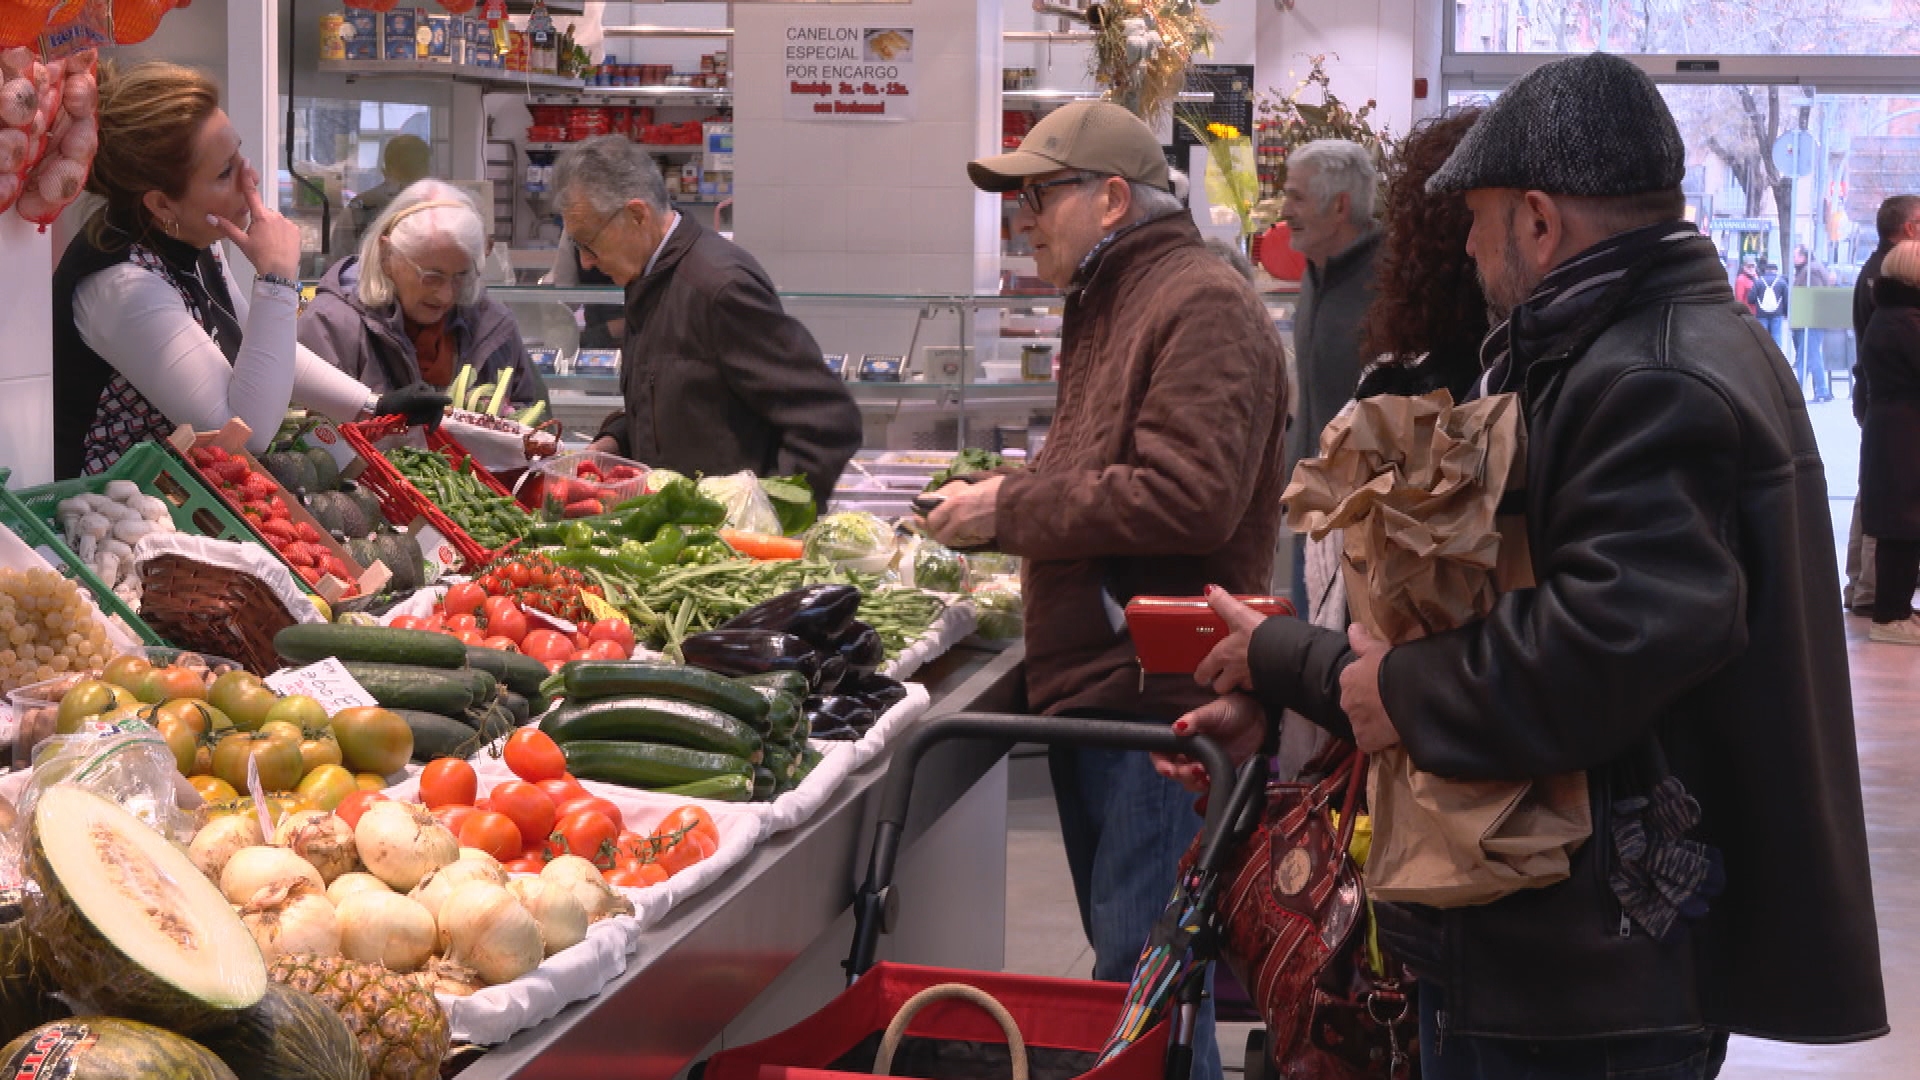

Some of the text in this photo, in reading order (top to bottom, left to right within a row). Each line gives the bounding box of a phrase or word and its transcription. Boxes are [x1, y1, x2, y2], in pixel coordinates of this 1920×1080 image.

[786, 27, 858, 41] CANELON
[786, 45, 859, 59] ESPECIAL
[786, 65, 898, 79] POR ENCARGO
